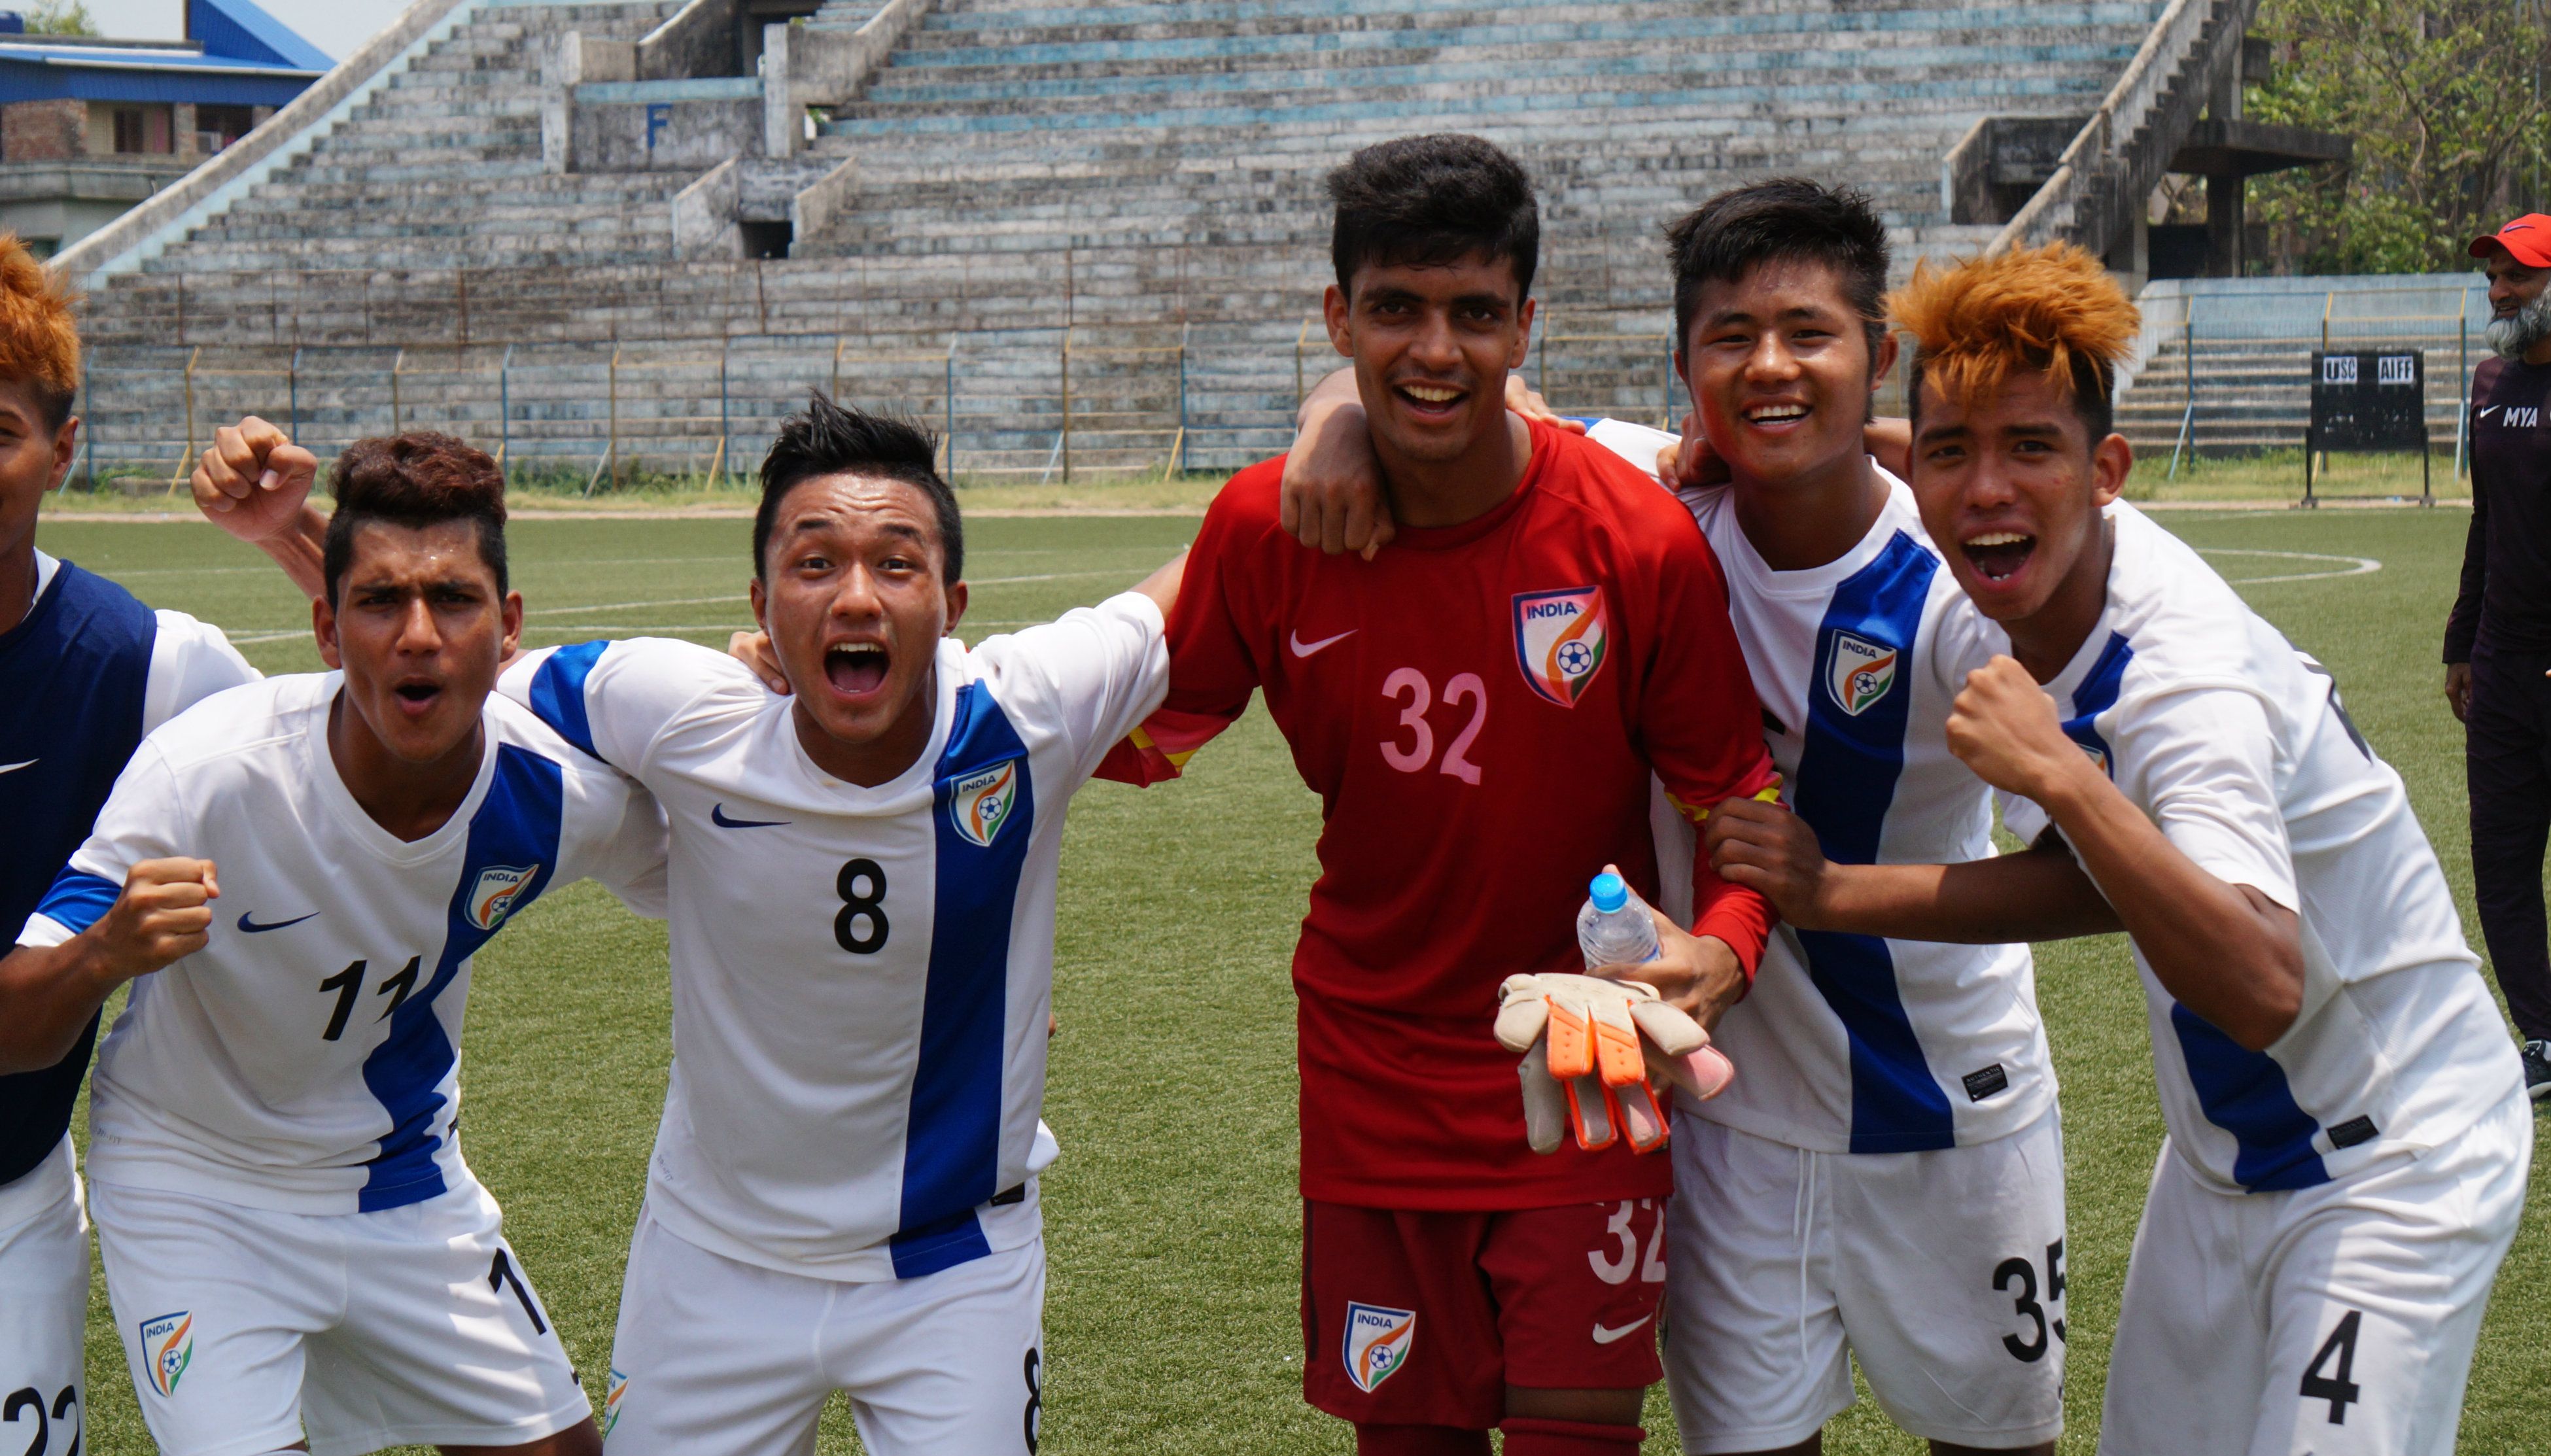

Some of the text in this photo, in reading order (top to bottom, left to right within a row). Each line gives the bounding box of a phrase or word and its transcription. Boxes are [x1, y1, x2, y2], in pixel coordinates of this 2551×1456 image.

[647, 104, 672, 150] F
[2326, 359, 2355, 379] USC
[2381, 360, 2412, 379] AIFF
[2503, 407, 2538, 427] MYA
[1527, 601, 1579, 620] INDIA
[1842, 640, 1877, 659] INDIA
[1379, 667, 1487, 786] 32
[962, 774, 997, 793] INDIA
[483, 872, 519, 885] INDIA
[834, 858, 890, 954] 8
[319, 954, 421, 1041] 11
[1588, 1198, 1667, 1285] 32
[146, 1322, 175, 1340] INDIA
[1357, 1313, 1393, 1330] INDIA
[2299, 1309, 2362, 1426] 4
[1024, 1347, 1041, 1456] 8
